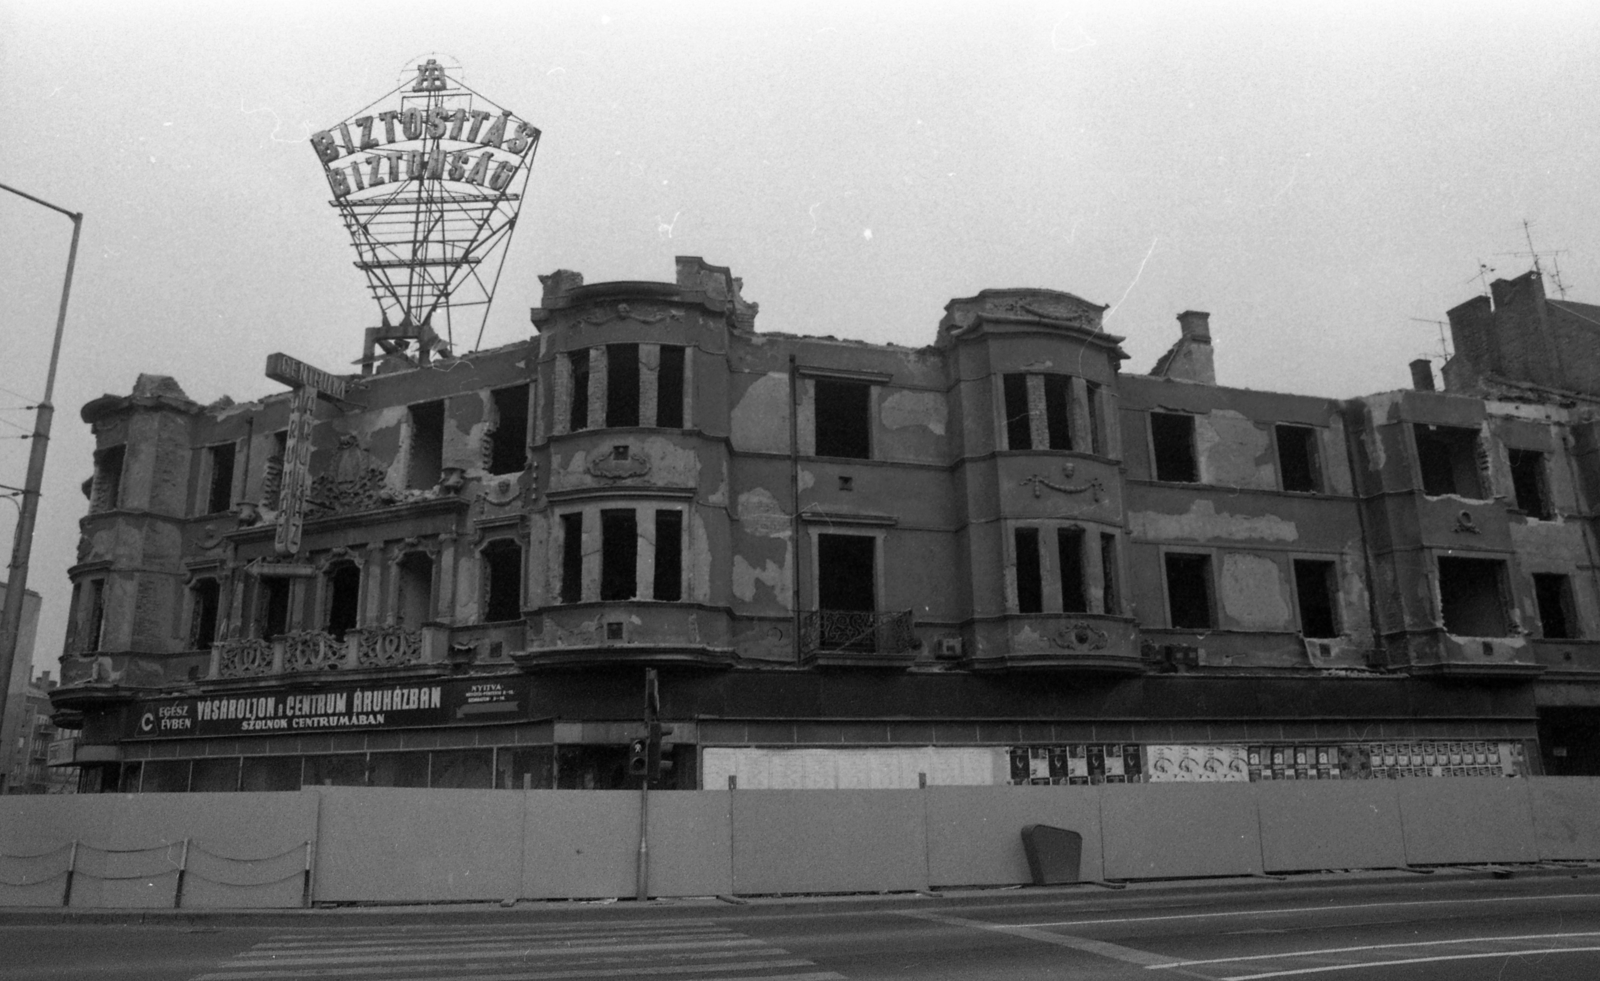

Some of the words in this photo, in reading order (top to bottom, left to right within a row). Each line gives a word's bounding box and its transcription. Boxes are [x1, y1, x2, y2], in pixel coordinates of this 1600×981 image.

[282, 356, 346, 399] CENTRUM
[159, 700, 189, 717] EGÉSZ
[197, 696, 276, 721] VÁSÁROLJON
[286, 692, 347, 717] CENTRUM
[353, 686, 441, 713] ÁRUHÁZBAN
[161, 716, 191, 730] ÉVBEN
[241, 718, 288, 730] SZOLNOK
[292, 712, 385, 728] CENTRUMÁBAN
